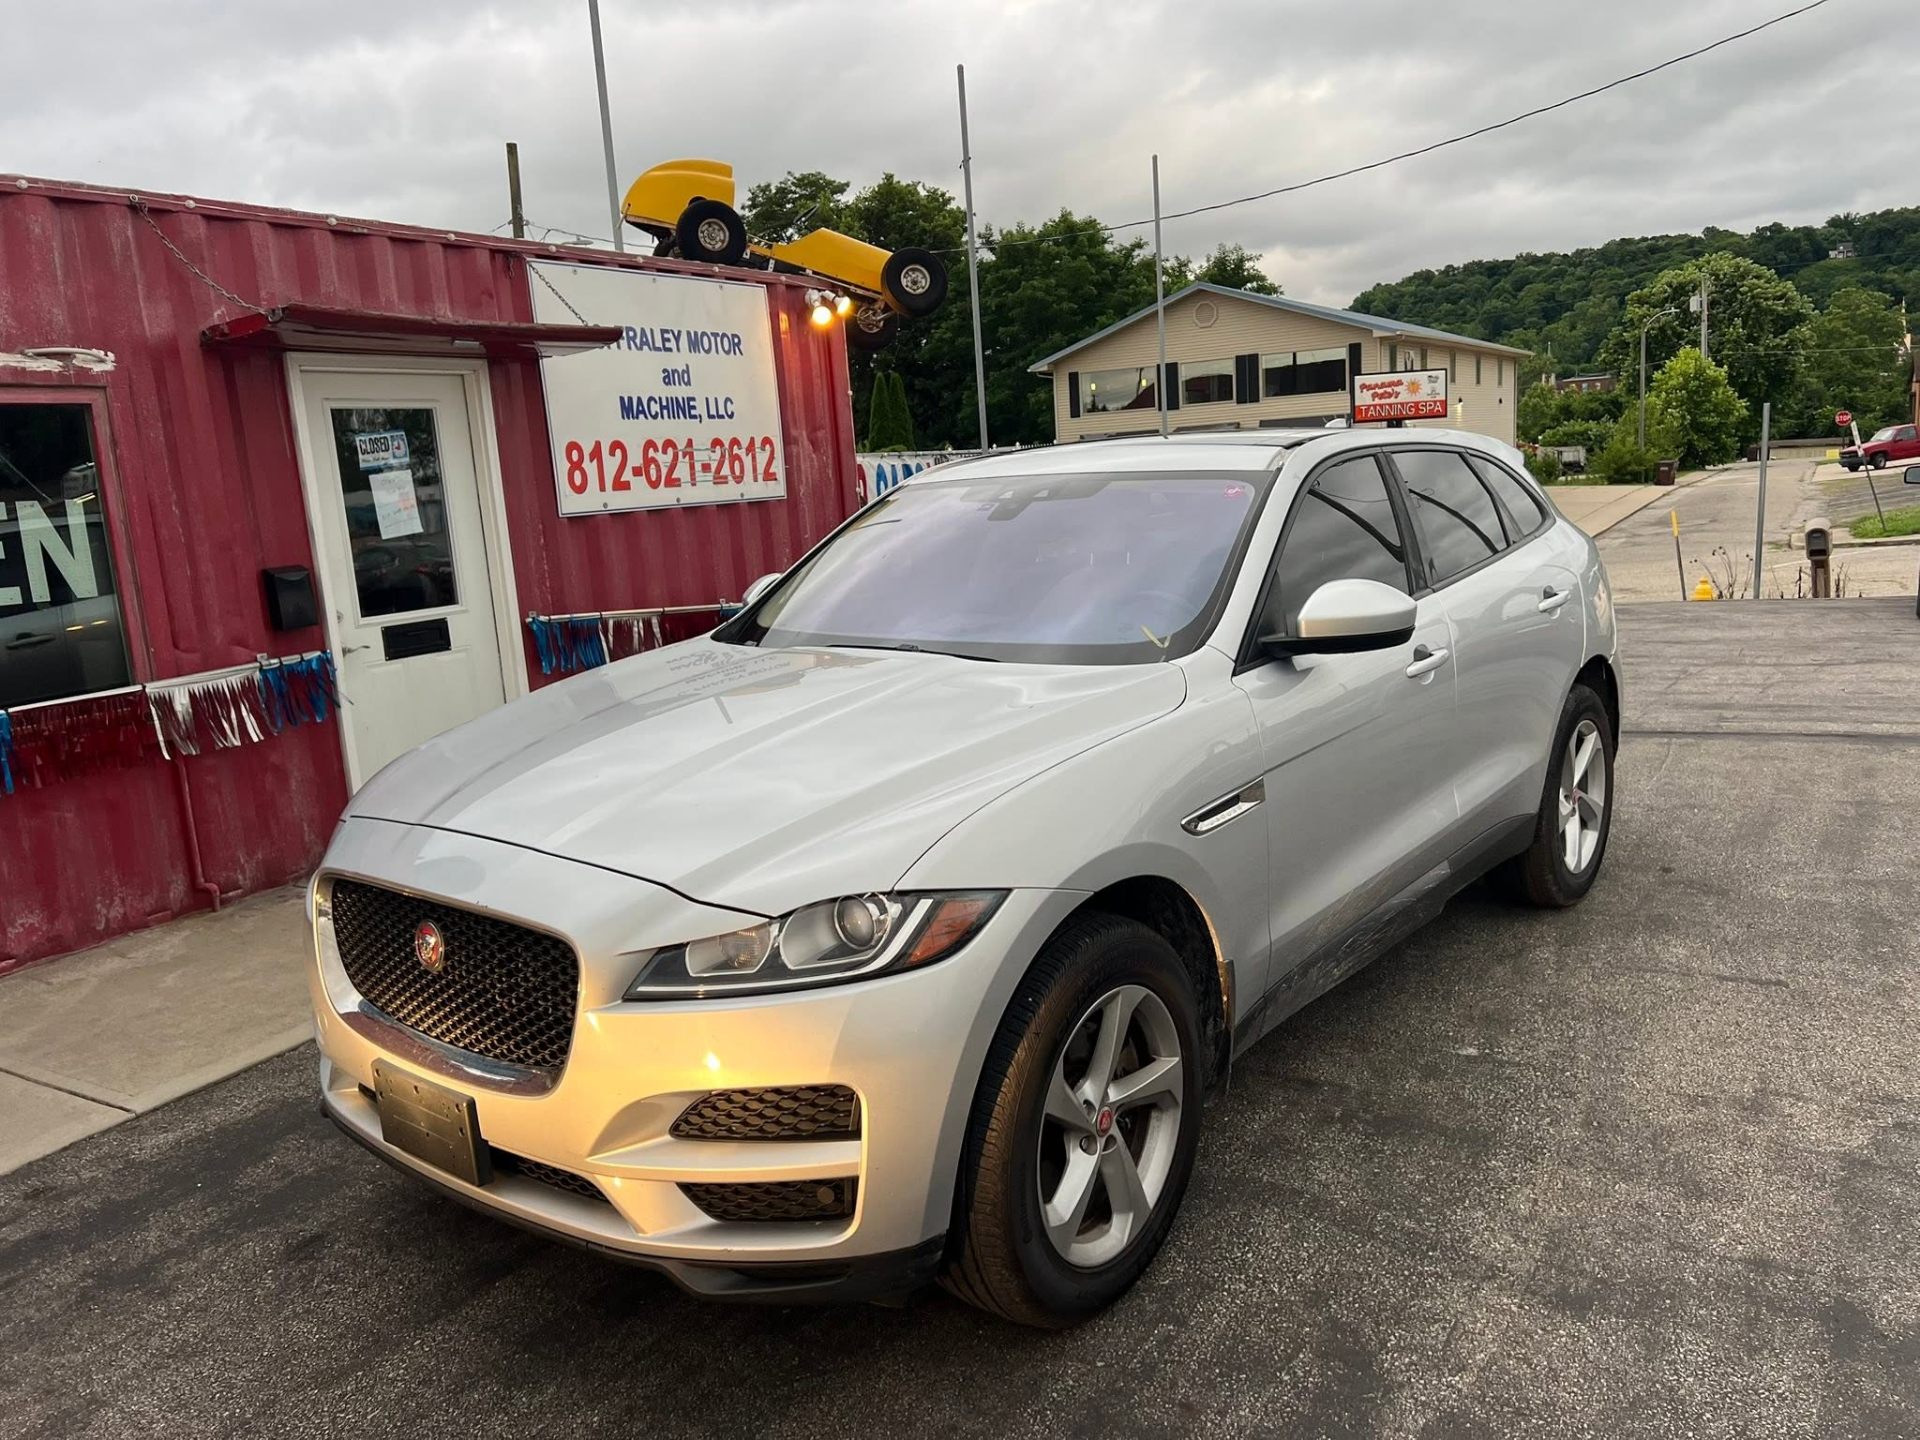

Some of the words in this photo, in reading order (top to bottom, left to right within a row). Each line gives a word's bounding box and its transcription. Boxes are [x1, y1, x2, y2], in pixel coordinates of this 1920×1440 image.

[687, 330, 743, 356] MOTOR
[662, 364, 692, 387] and
[619, 395, 703, 424] MACHINE,
[705, 396, 735, 420] LLC
[1360, 403, 1416, 417] TANNING
[1418, 401, 1442, 414] SPA
[359, 436, 390, 455] CLOSED
[565, 436, 778, 495] 812-621-2612
